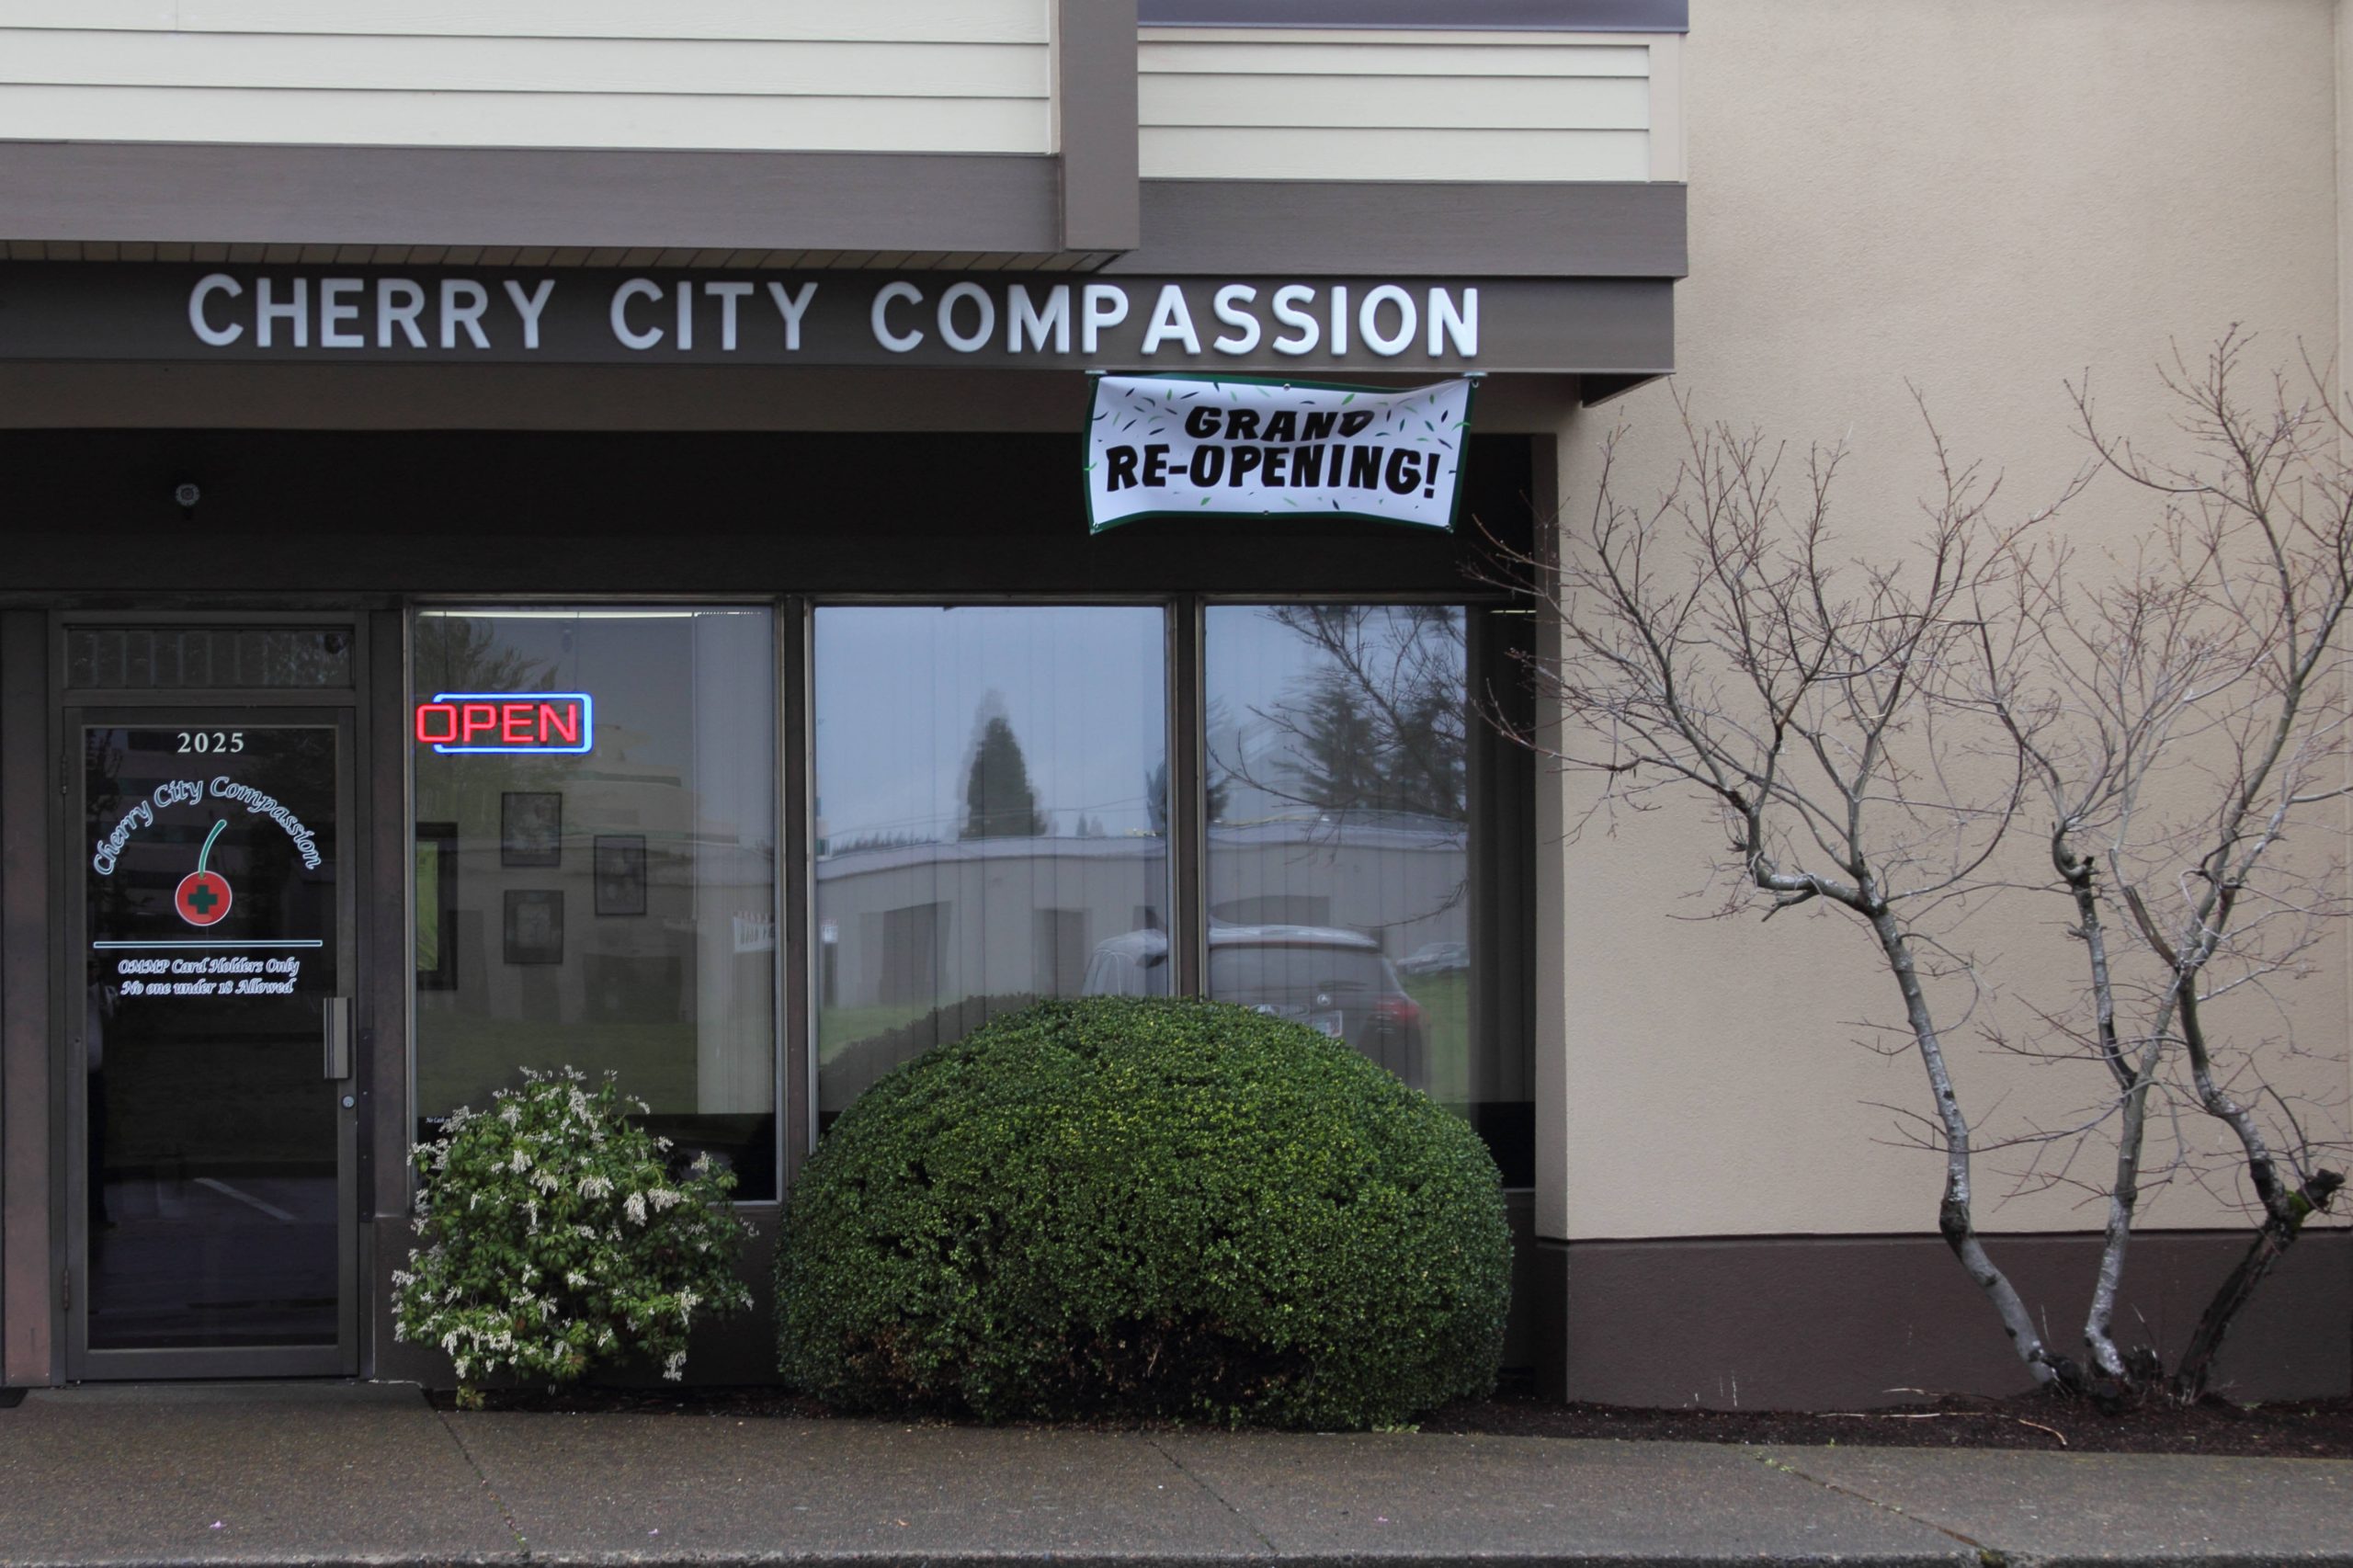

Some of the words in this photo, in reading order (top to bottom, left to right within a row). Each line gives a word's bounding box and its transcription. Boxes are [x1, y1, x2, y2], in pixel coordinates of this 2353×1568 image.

[188, 273, 555, 350] CHERRY
[609, 277, 819, 351] CITY
[870, 280, 1479, 358] COMPASSION
[1184, 405, 1375, 443] GRAND
[1105, 443, 1441, 499] RE-OPENING!
[176, 732, 244, 753] 2025
[415, 703, 579, 744] OPEN
[93, 800, 153, 876] Cherry
[153, 779, 204, 806] City
[210, 777, 322, 870] Compassion
[118, 960, 169, 974] OMMP
[172, 958, 210, 974] Card
[208, 957, 264, 974] Holders
[266, 956, 301, 977] Only
[120, 980, 144, 995] No
[145, 982, 171, 994] one
[173, 978, 217, 995] under
[219, 981, 233, 994] 18
[234, 977, 296, 994] Allowed
